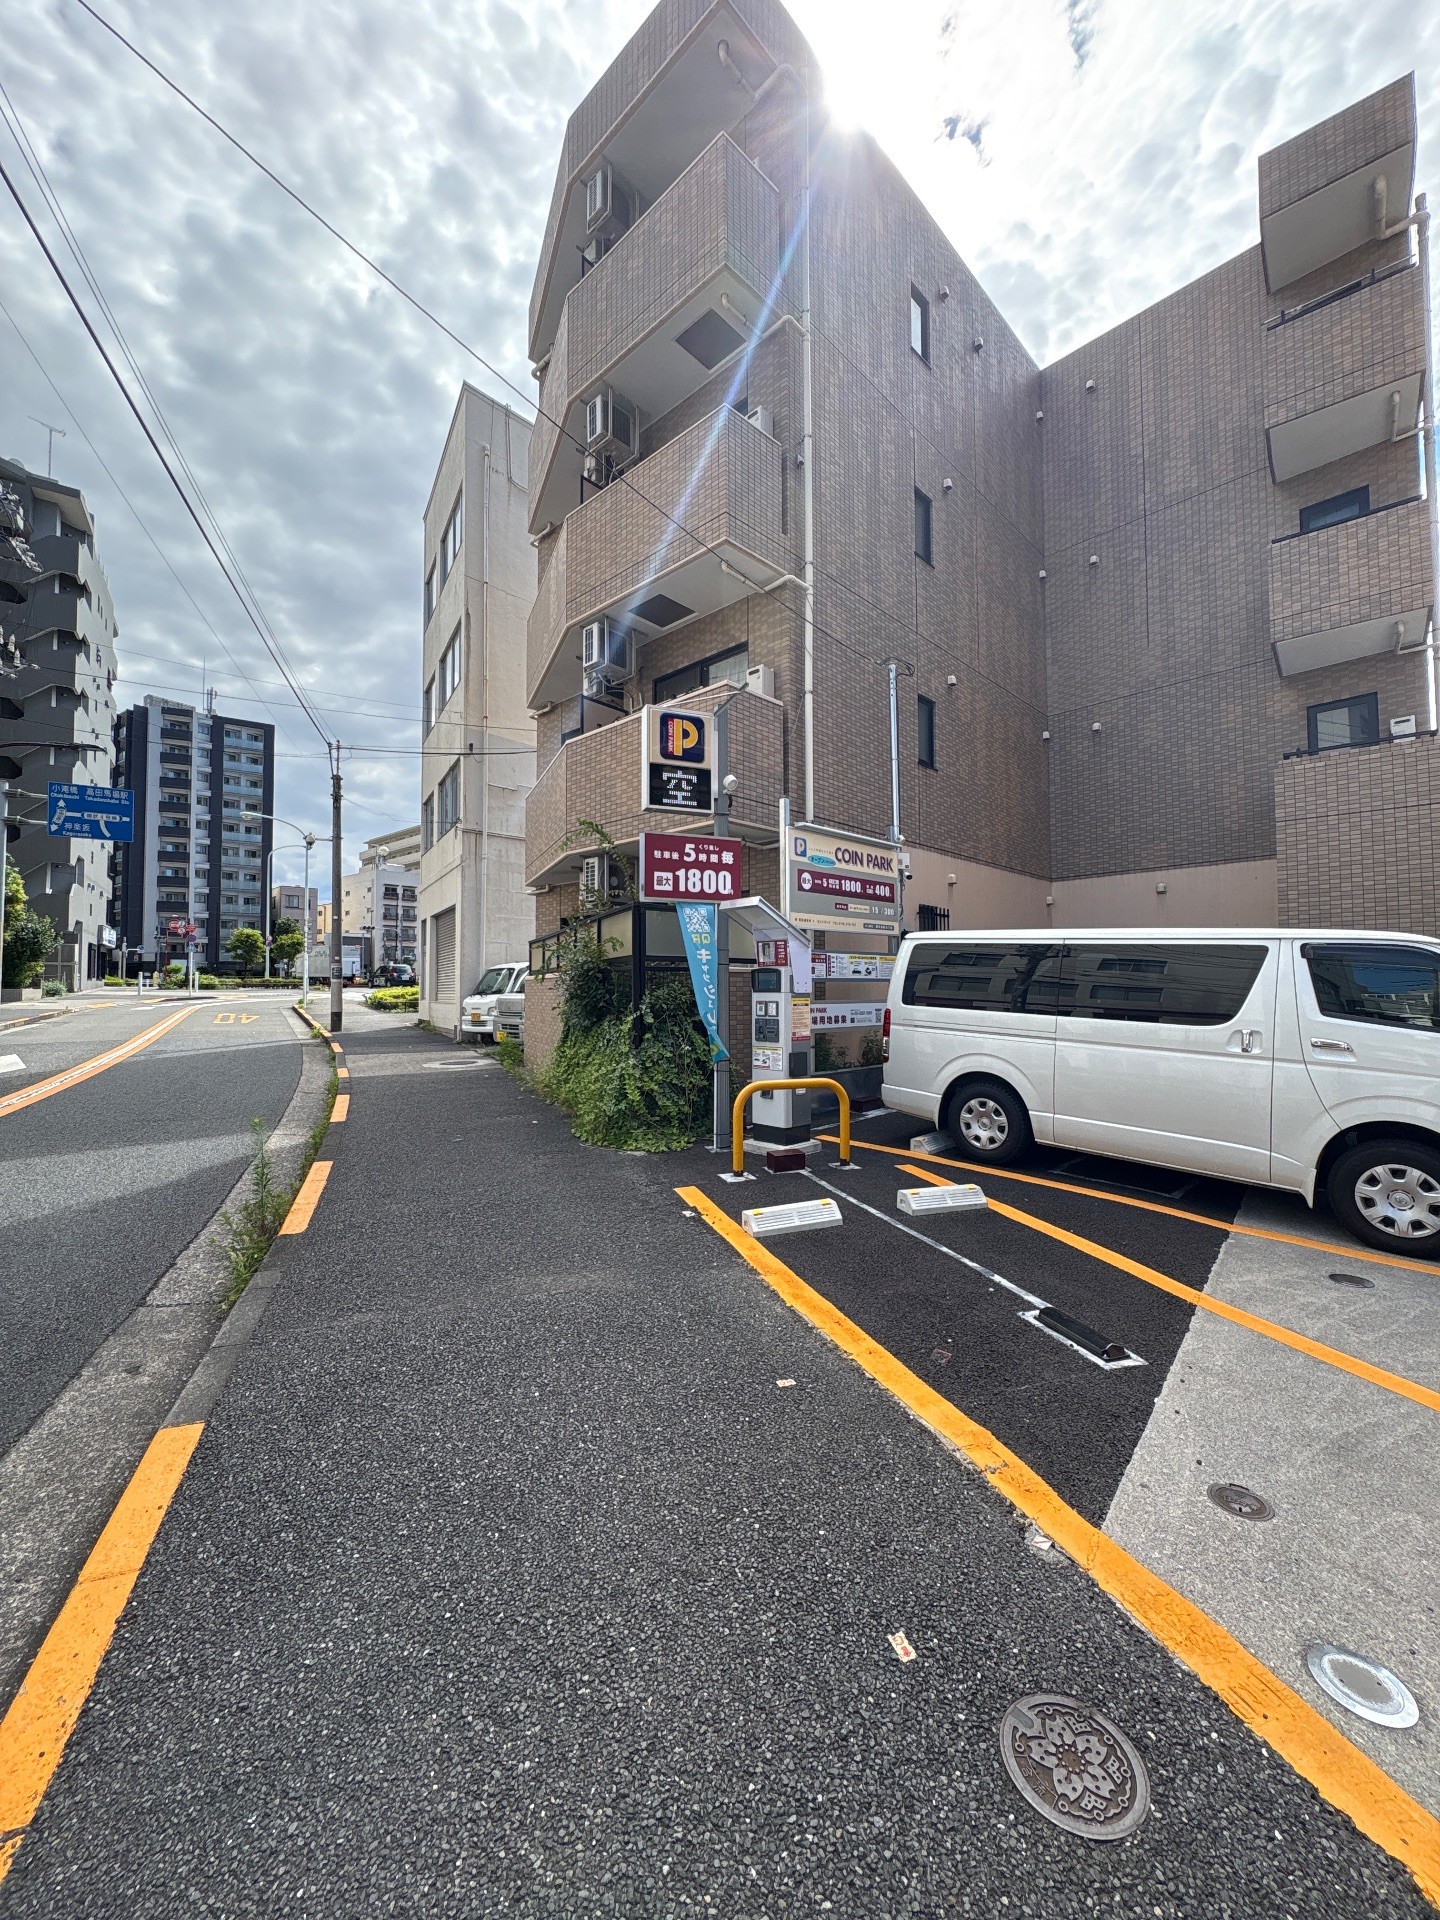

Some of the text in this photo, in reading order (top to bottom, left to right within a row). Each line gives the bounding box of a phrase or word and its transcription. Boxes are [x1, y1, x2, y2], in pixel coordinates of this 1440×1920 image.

[86, 787, 129, 800] 高田馬場駅
[662, 770, 698, 806] 空
[64, 822, 91, 832] 神楽坂
[834, 847, 894, 873] COIN PARK
[656, 875, 671, 887] 最大
